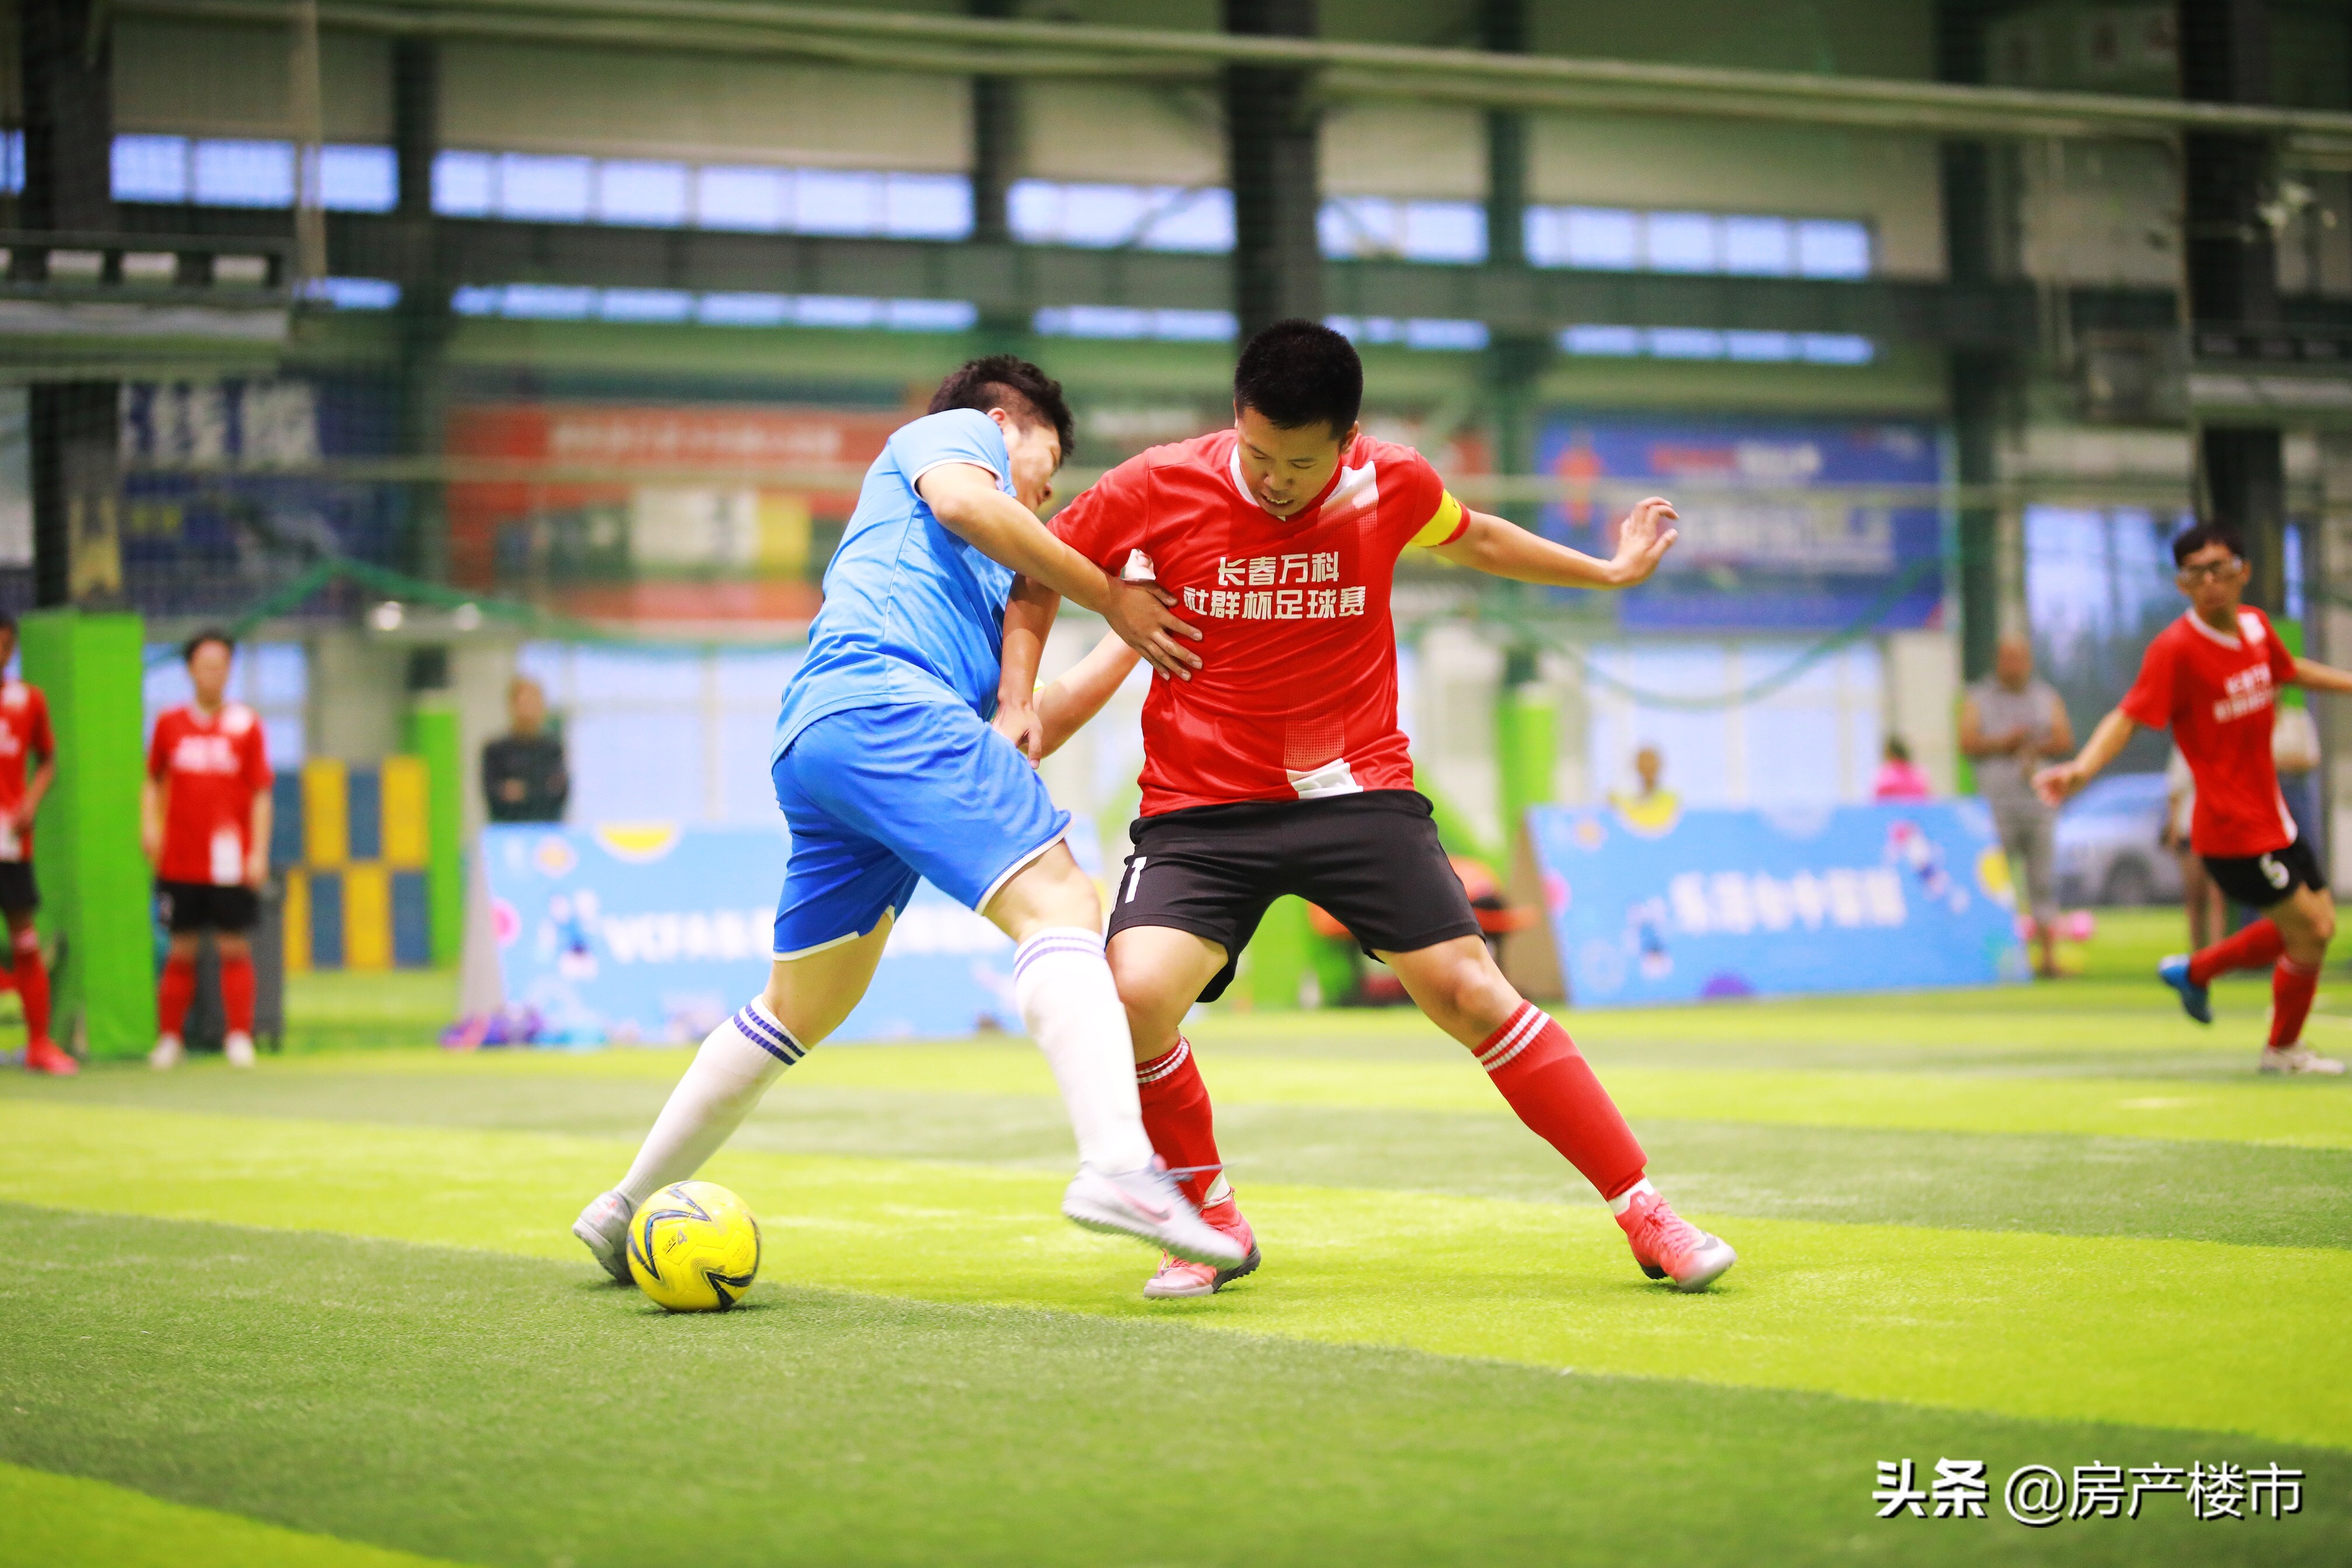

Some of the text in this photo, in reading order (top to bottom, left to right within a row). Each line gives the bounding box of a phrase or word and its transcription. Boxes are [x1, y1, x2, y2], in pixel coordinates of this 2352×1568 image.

[1217, 551, 1340, 586] 长春万科
[1183, 586, 1367, 620] 社群杯足球赛
[1114, 856, 1148, 911] 1
[662, 1229, 688, 1252] SIZE 4
